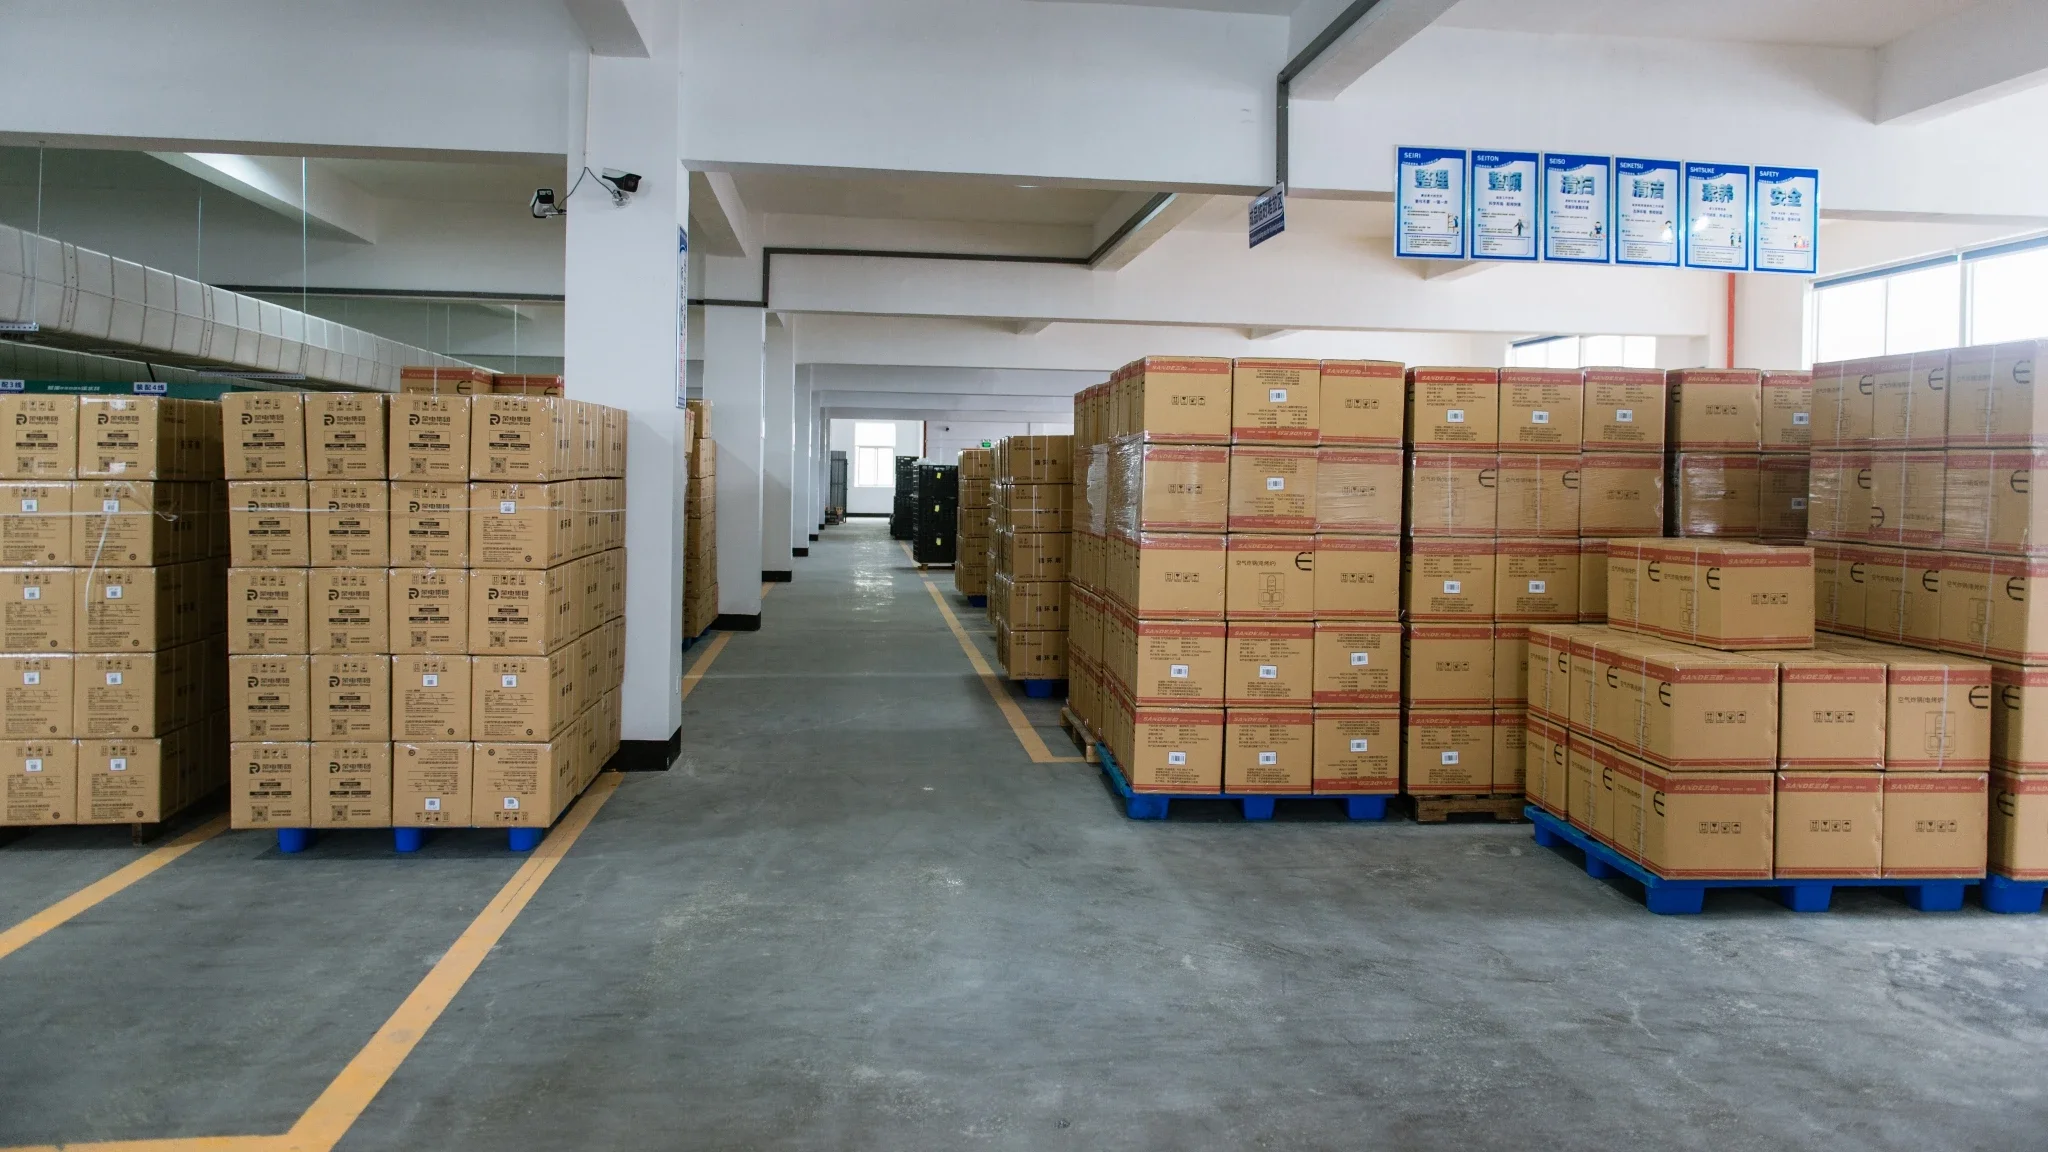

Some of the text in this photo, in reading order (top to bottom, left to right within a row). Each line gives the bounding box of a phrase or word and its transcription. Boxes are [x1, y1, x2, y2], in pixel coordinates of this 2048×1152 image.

[1619, 162, 1644, 170] SEIKETSU
[1414, 168, 1450, 190] 整理
[1488, 170, 1523, 193] 整顿
[1560, 174, 1595, 196] 清扫
[1631, 178, 1665, 200] 清洁
[1701, 182, 1734, 204] 素养
[1770, 186, 1803, 207] 安全
